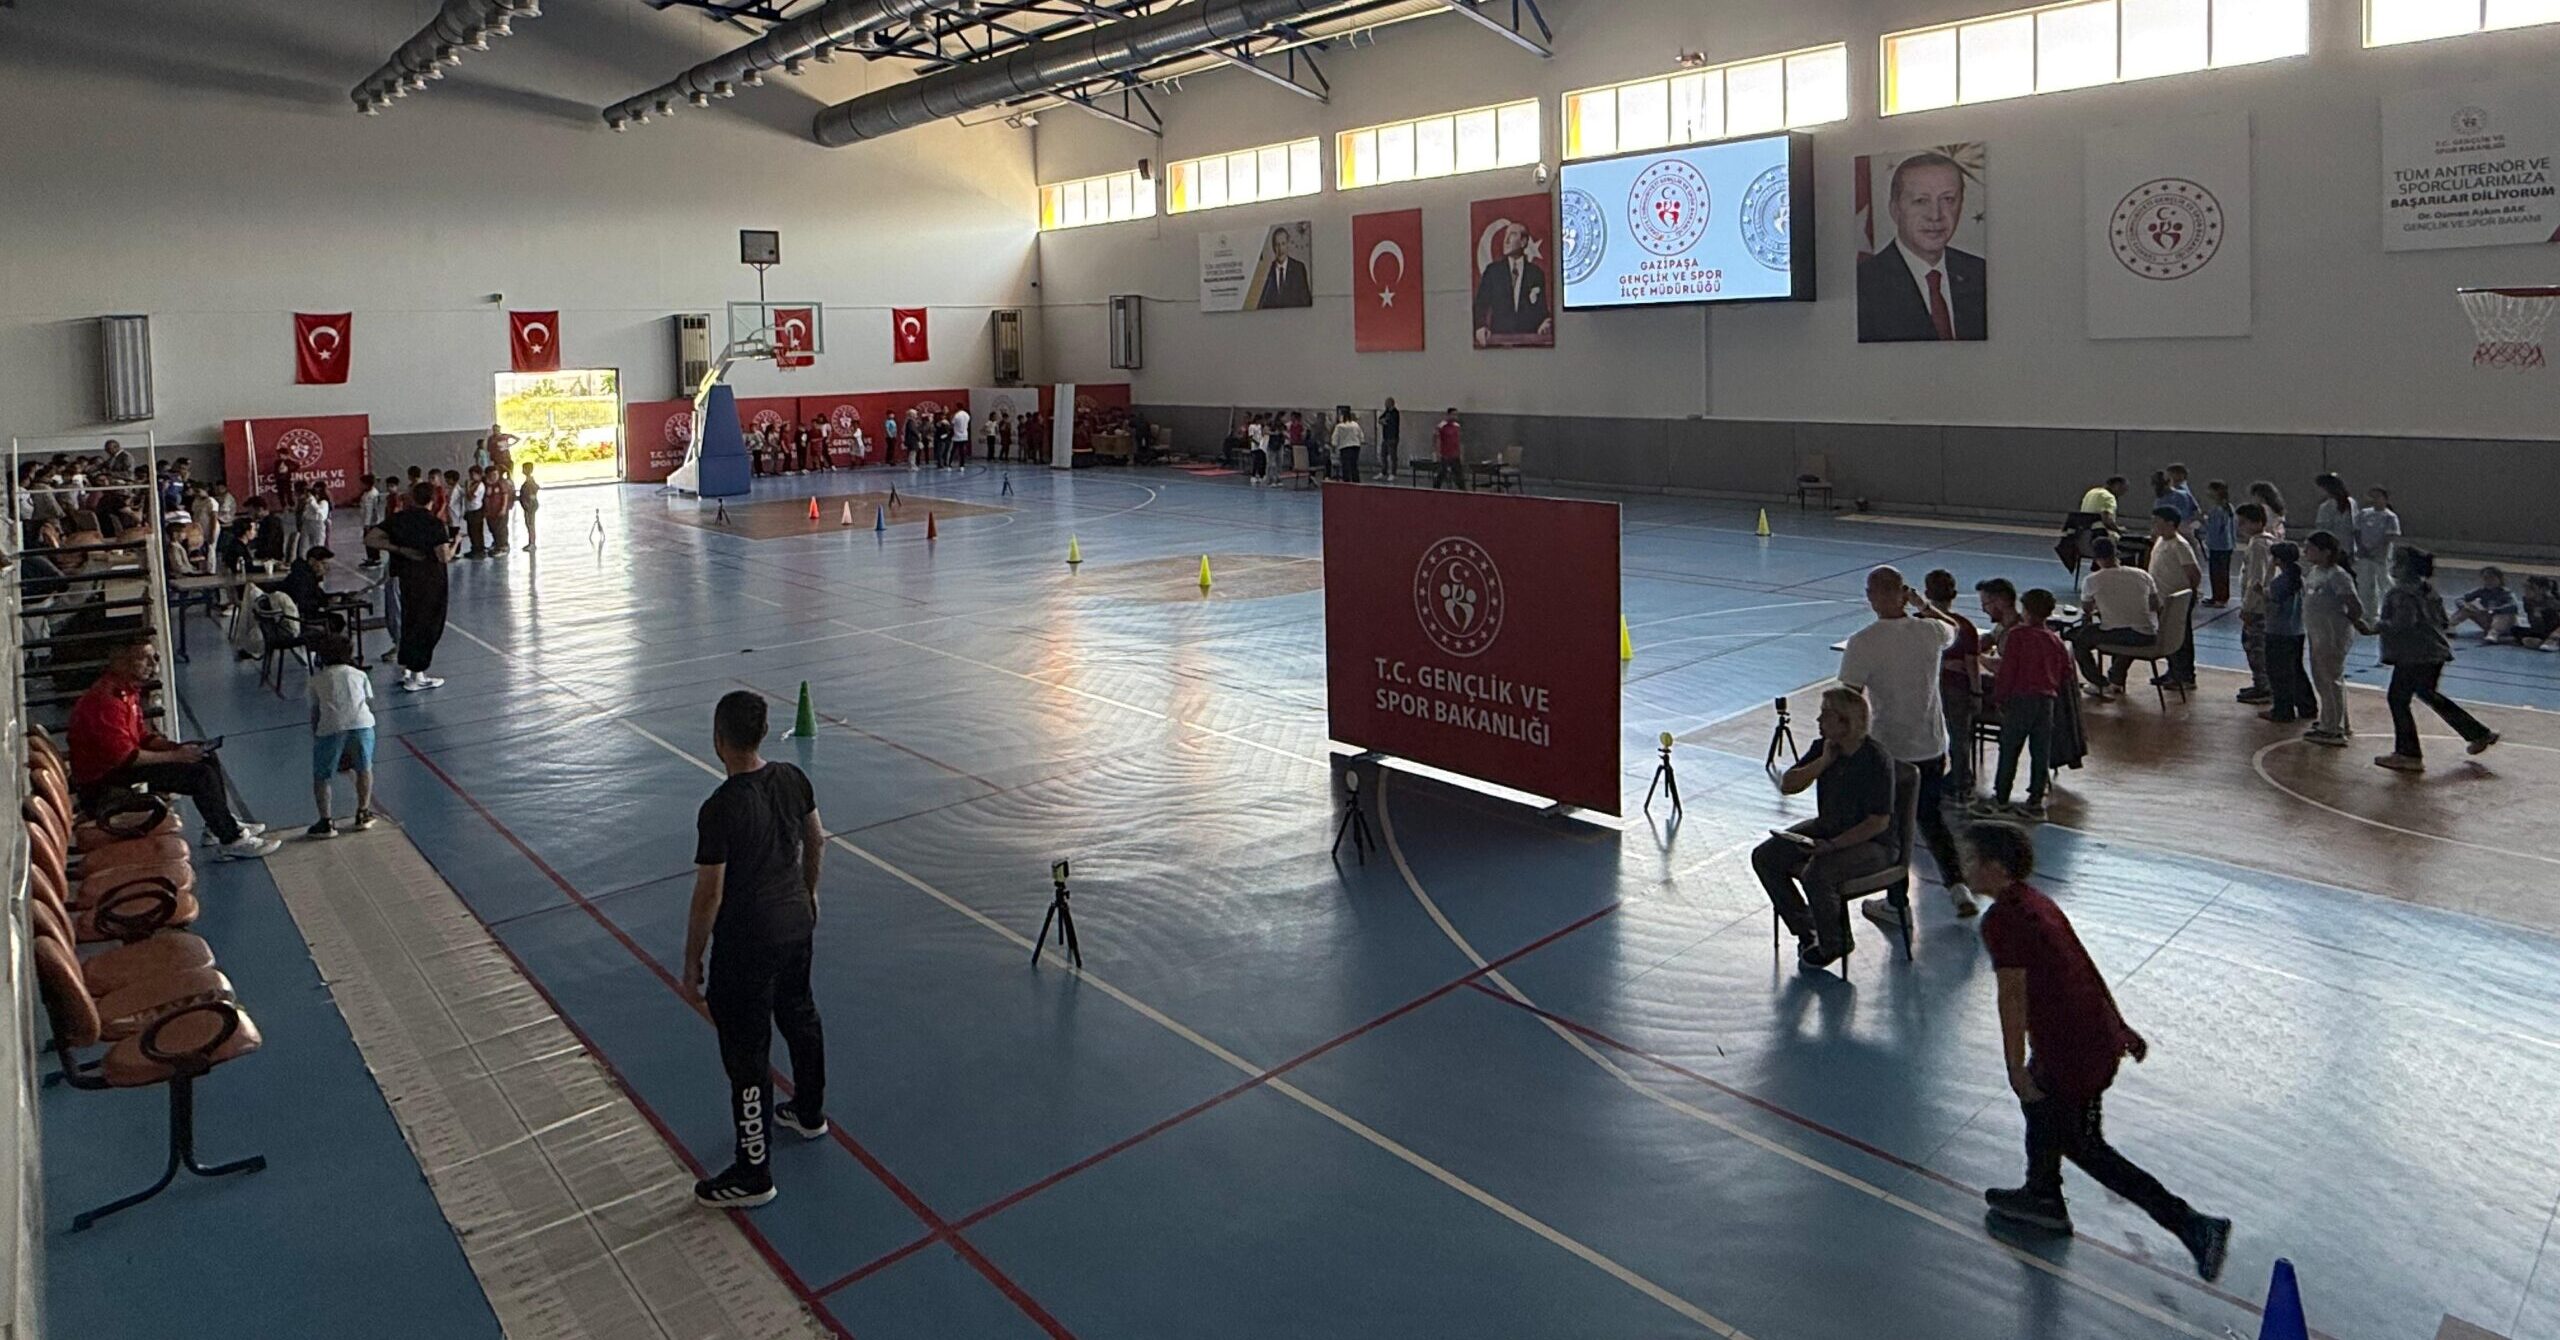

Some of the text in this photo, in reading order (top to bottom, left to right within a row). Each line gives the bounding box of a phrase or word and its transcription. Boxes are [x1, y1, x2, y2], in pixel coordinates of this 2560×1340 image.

[2394, 157, 2550, 182] TÜM ANTRENÖR VE
[2399, 172, 2545, 195] SPORCULARIMIZA
[2391, 186, 2555, 208] BAŞARILAR DİLİYORUM
[2403, 214, 2542, 231] GENÇLİK VE SPOR BAKANI
[1640, 257, 1699, 271] GAZİPAŞA
[1619, 269, 1722, 286] GENÇLİK VE SPOR
[1621, 280, 1720, 300] İLÇE MÜDÜRLÜĞÜ
[330, 469, 345, 477] VE
[1374, 657, 1550, 713] T.C. GENÇLİK VE
[1375, 687, 1550, 747] SPOR BAKANLIĞI
